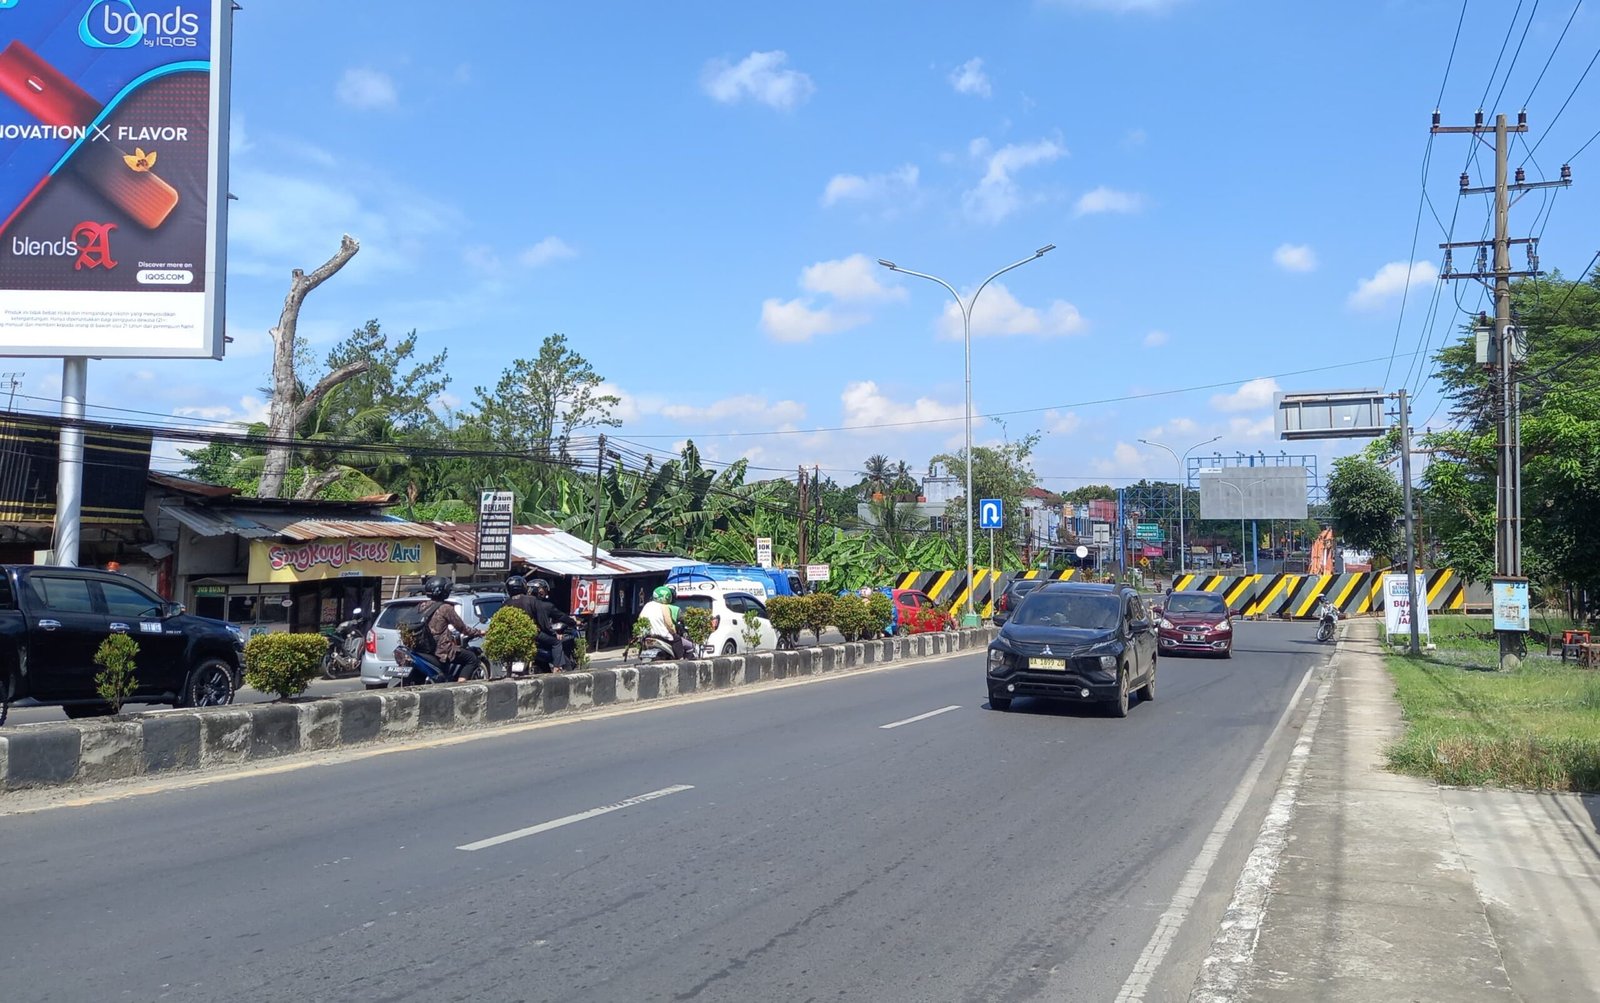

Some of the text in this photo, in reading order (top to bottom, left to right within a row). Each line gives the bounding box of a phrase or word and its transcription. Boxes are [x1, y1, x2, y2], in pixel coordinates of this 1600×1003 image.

[104, 4, 199, 36] bonds
[144, 36, 197, 47] by IQOS
[0, 124, 86, 140] OVATION
[118, 126, 188, 141] FLAVOR
[12, 236, 78, 256] blends
[145, 273, 185, 281] IQOS.COM
[483, 503, 510, 512] REKLAME
[344, 539, 389, 564] Kress
